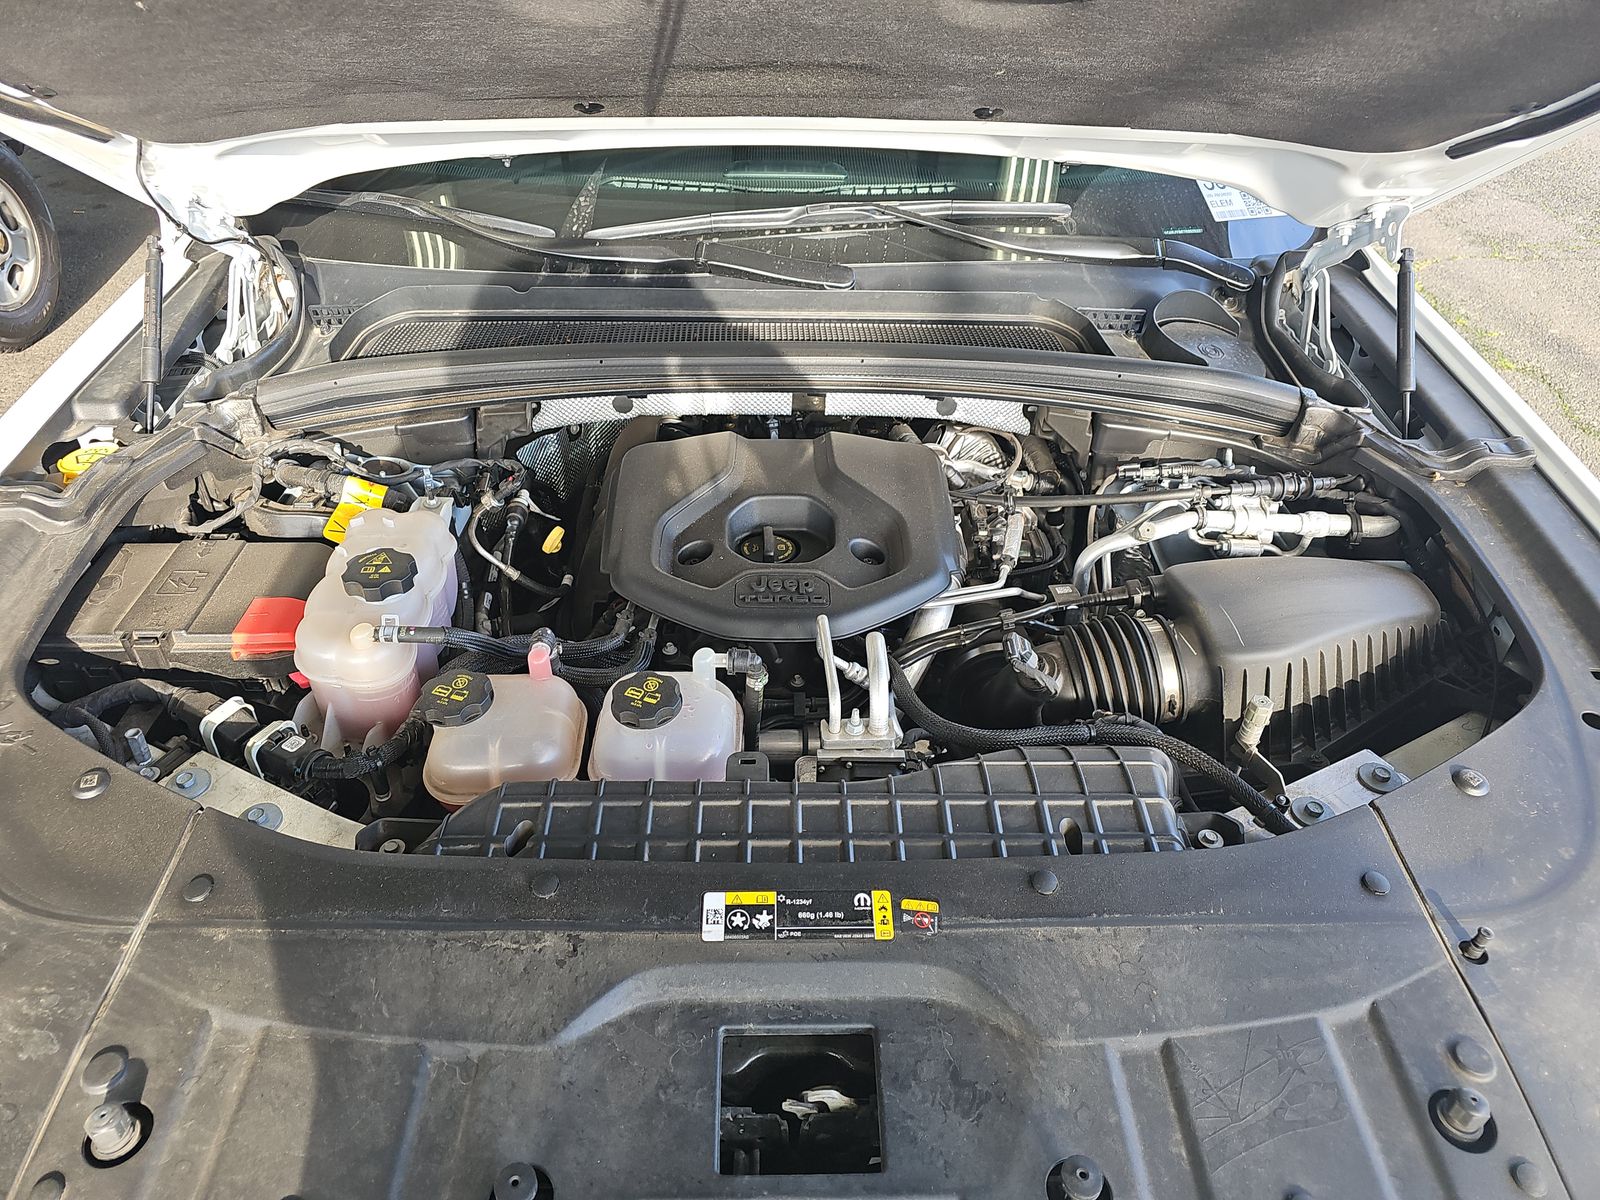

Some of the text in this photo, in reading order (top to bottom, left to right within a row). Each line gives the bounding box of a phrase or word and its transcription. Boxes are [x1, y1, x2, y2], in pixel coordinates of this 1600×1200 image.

[1209, 198, 1234, 208] ELEM
[750, 575, 815, 594] Jeep
[785, 898, 813, 906] R-1234yf
[834, 911, 845, 920] lb)
